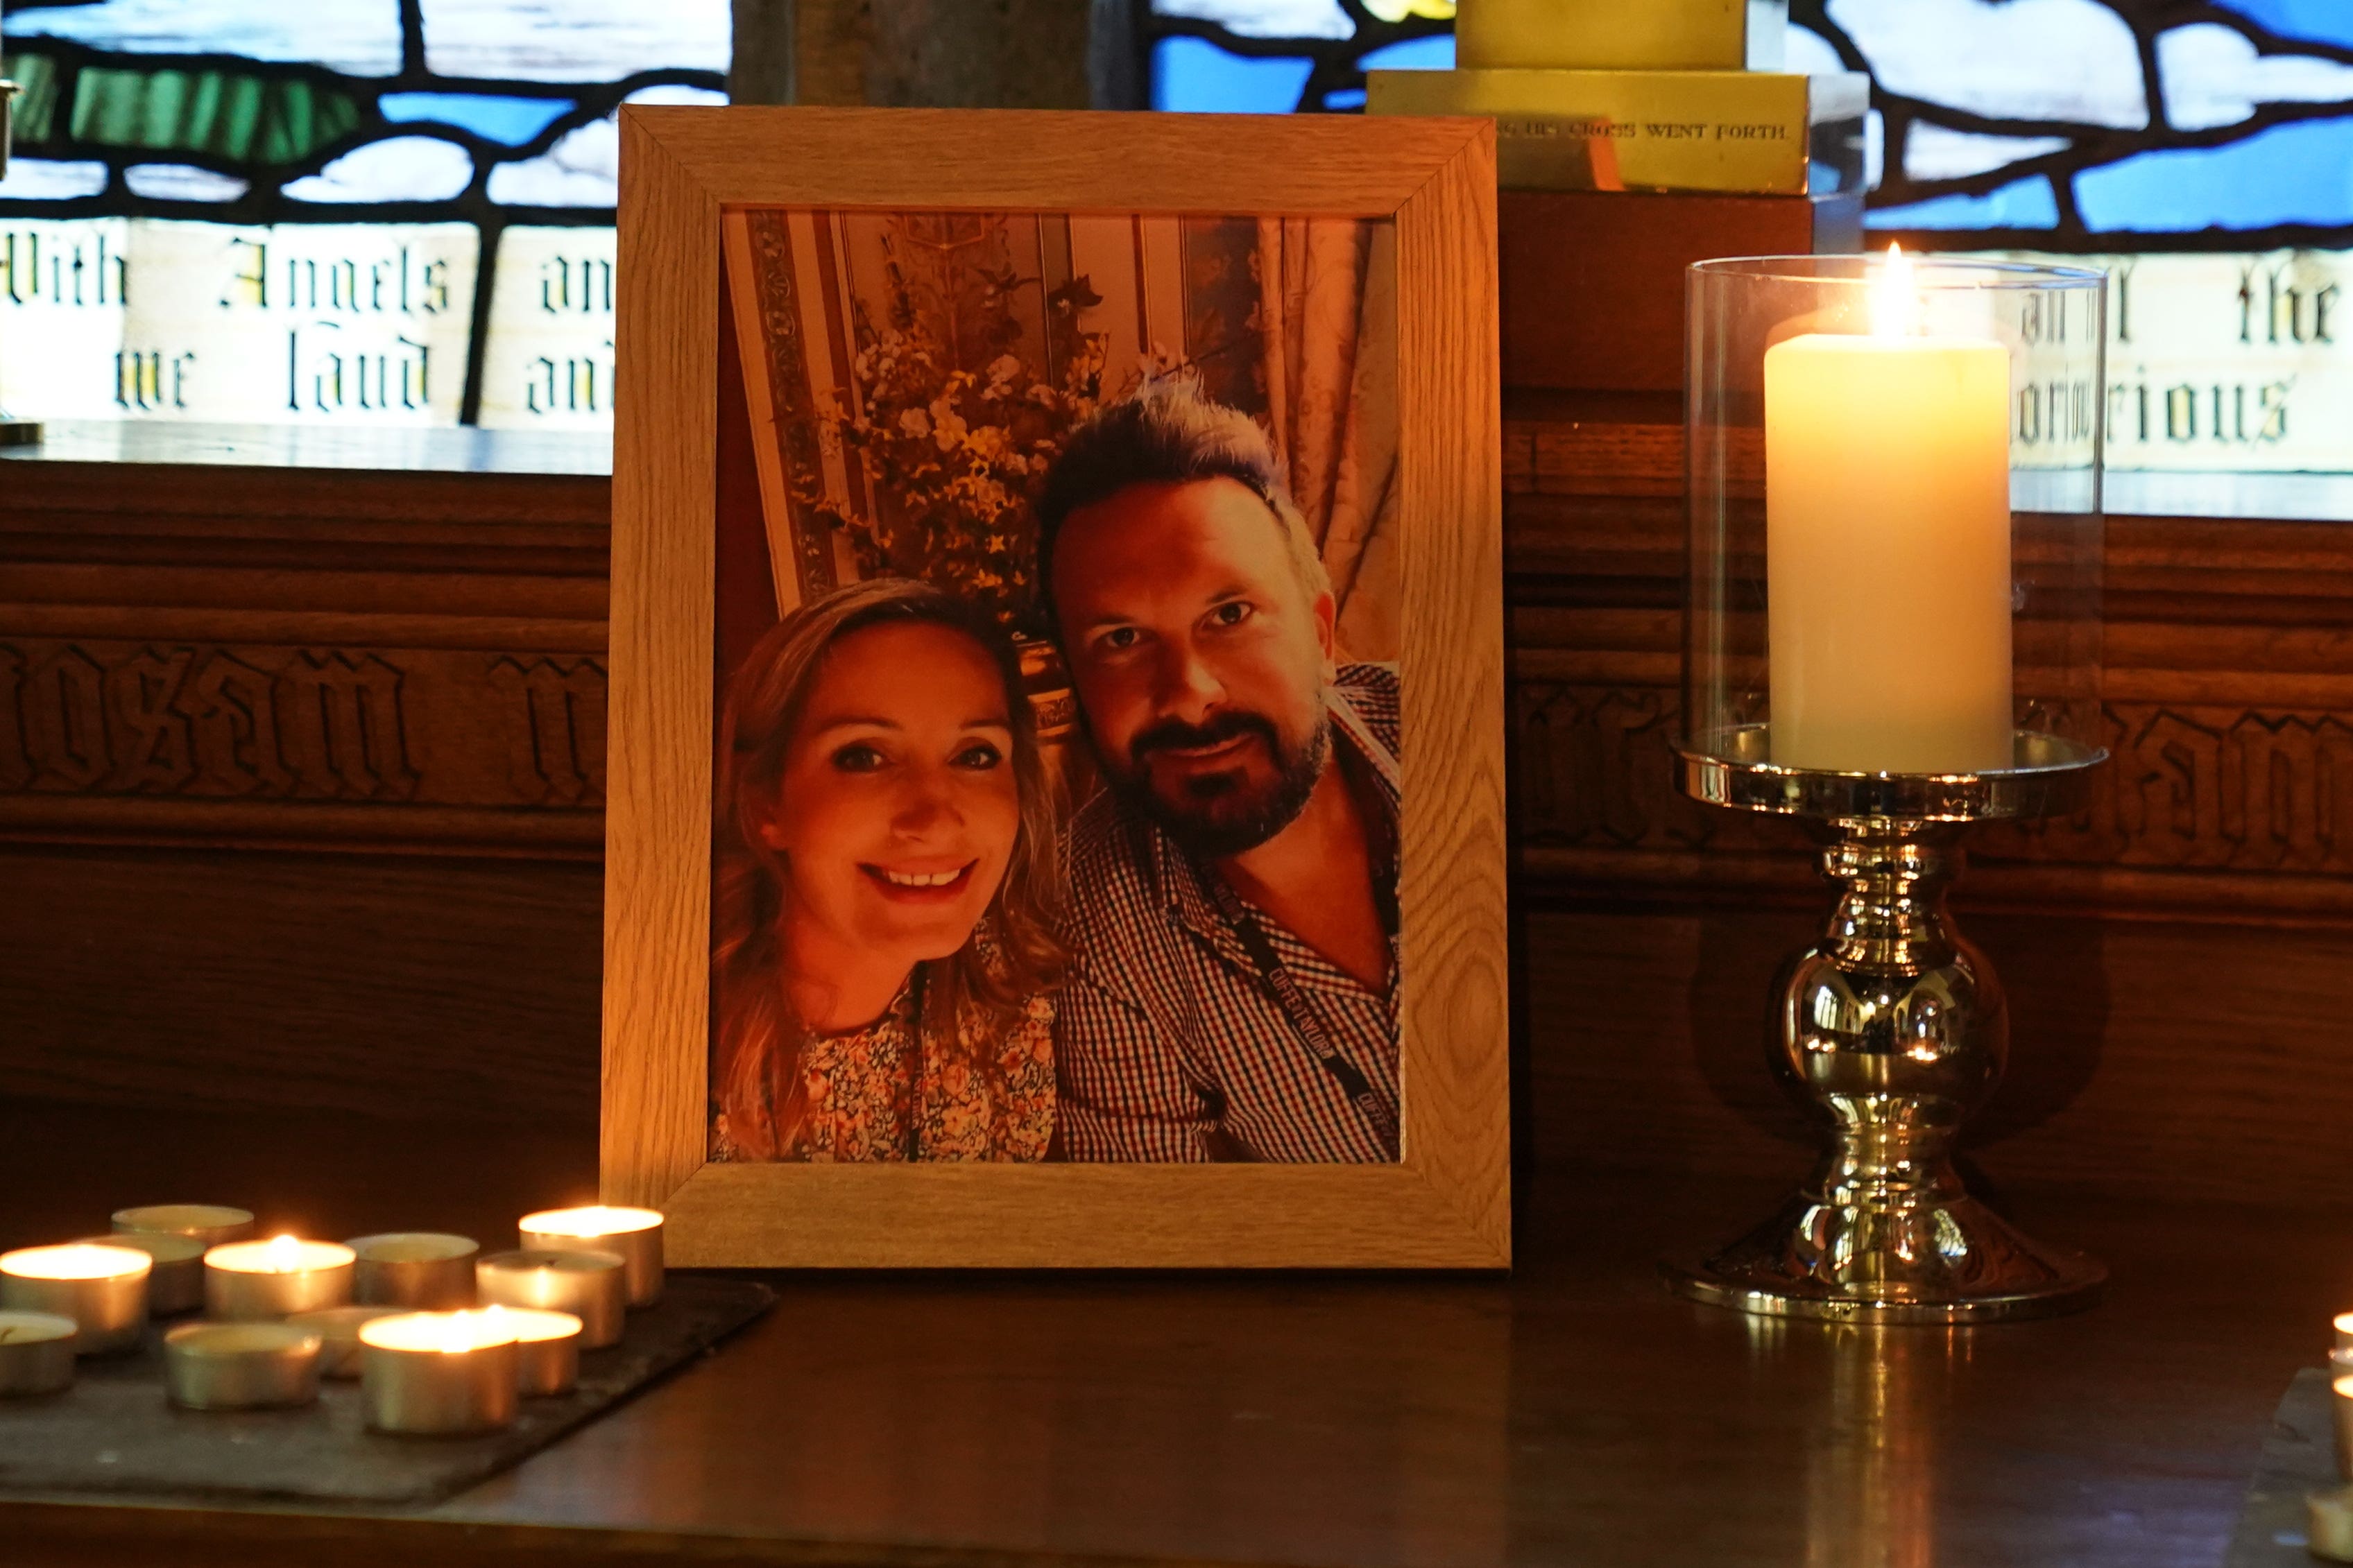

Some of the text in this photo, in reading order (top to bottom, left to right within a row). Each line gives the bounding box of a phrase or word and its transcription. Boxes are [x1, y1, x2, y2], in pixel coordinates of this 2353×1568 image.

[1570, 121, 1636, 137] CROSS
[1645, 123, 1707, 139] WENT
[219, 236, 448, 315] Angels
[541, 255, 612, 313] an
[2237, 264, 2341, 344] the
[114, 351, 197, 411] we
[285, 321, 429, 413] laud
